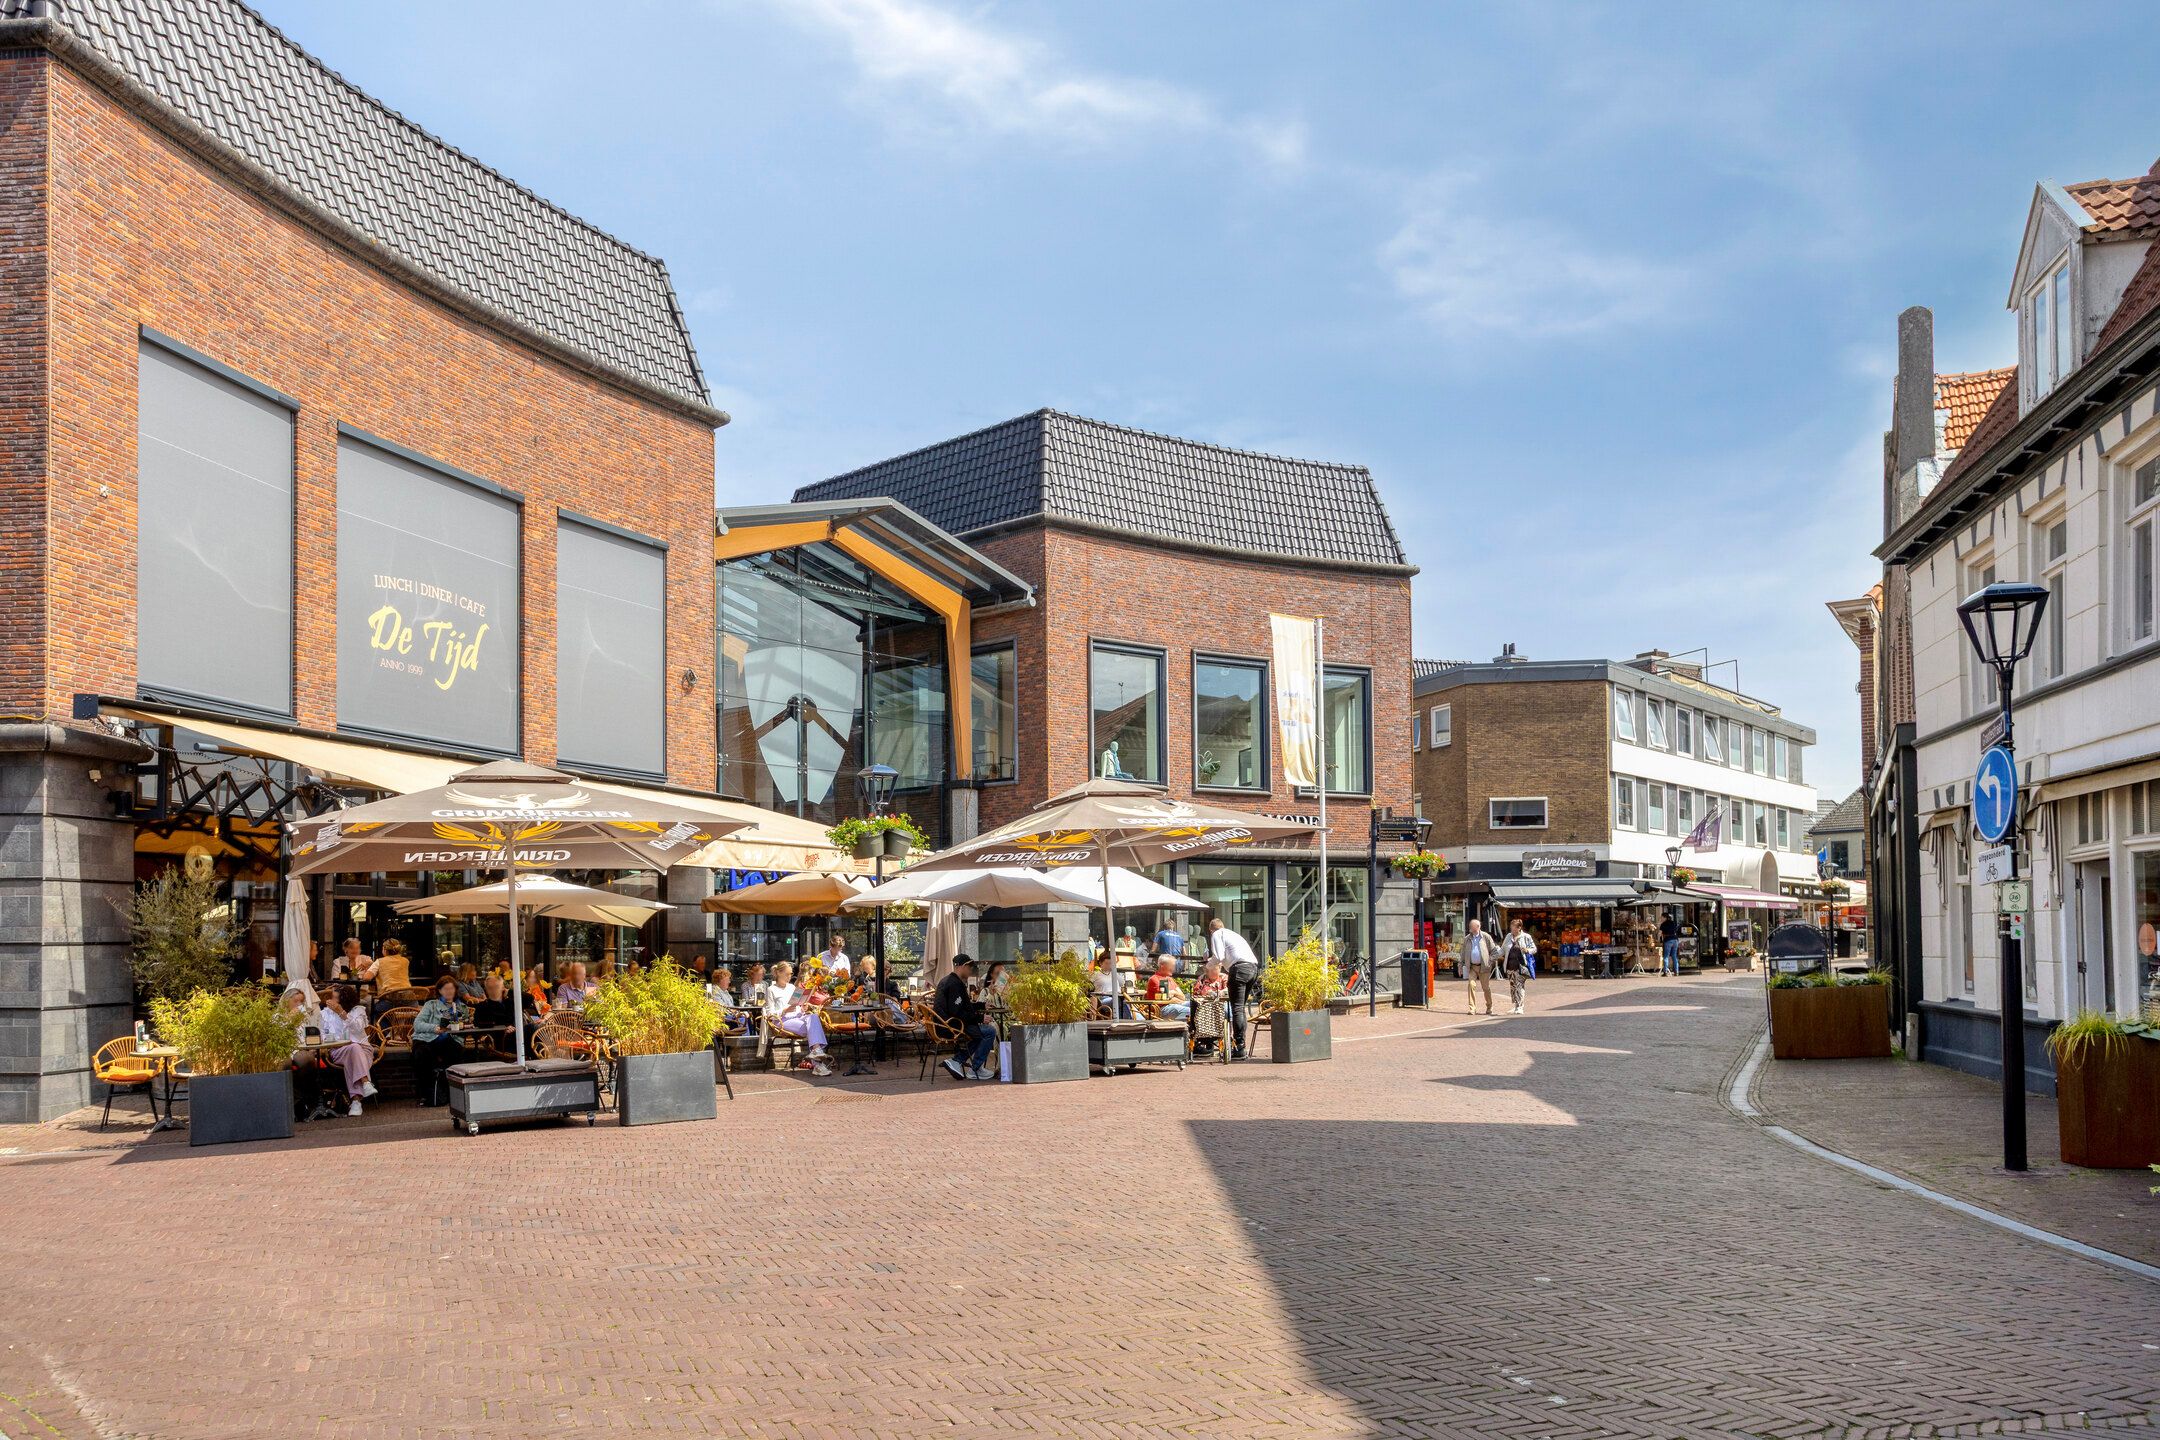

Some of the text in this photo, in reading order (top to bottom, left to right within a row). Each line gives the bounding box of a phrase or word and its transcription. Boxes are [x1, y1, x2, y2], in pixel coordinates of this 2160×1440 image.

[374, 574, 413, 593] LUNCH
[420, 583, 453, 604] DINER
[368, 604, 490, 691] De Tijd
[379, 658, 405, 672] ANNO
[431, 809, 633, 818] GRIMBERGEN
[1531, 856, 1588, 871] Zuivelhoeve
